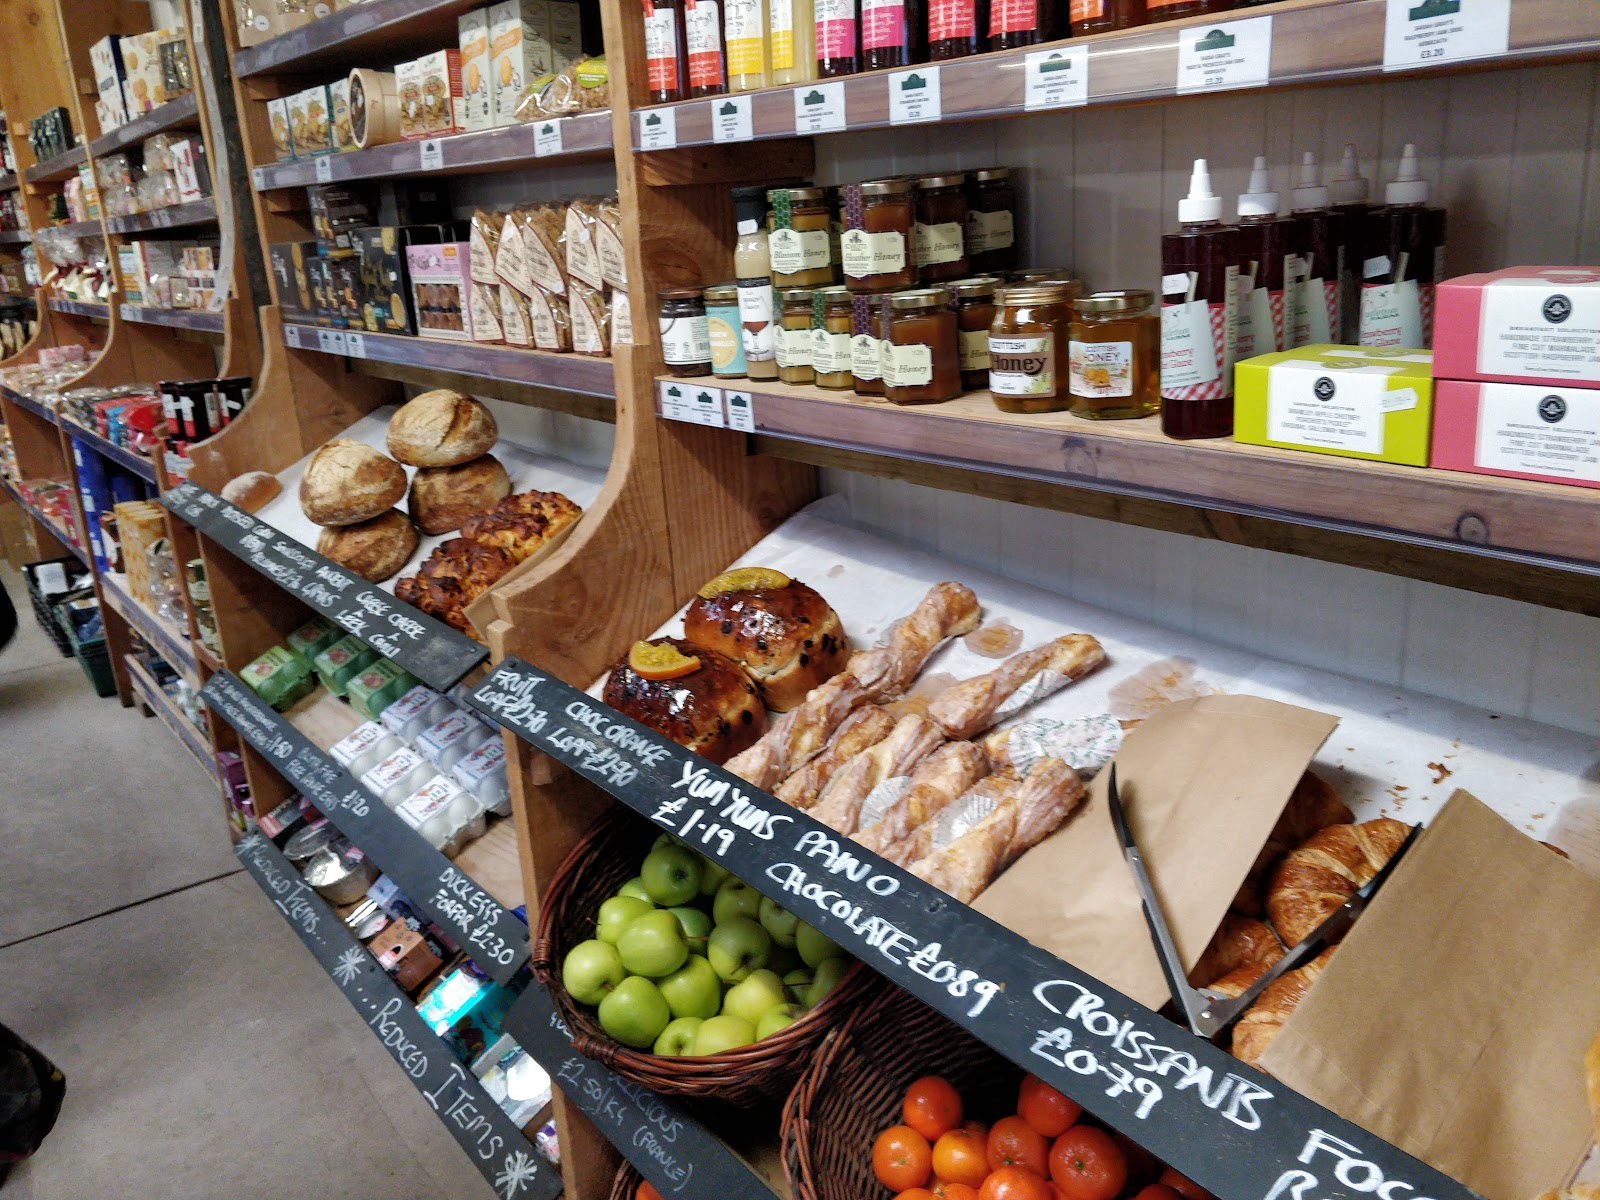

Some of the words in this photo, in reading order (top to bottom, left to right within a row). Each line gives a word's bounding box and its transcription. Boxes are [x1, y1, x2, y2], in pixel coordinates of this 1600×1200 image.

[803, 248, 826, 259] Honey
[873, 252, 901, 262] Honey
[991, 341, 1026, 350] SCOTTISH
[1499, 333, 1540, 341] HANDMADE
[1542, 335, 1593, 344] STRAWBERRY
[1512, 342, 1529, 350] FINE
[1547, 344, 1597, 354] MARMALADE
[898, 364, 928, 375] Honey
[993, 355, 1048, 376] Honey
[491, 669, 546, 697] FRUIT
[473, 684, 519, 713] LOAF
[546, 727, 597, 757] LOAF
[565, 701, 610, 736] CHOC
[604, 725, 672, 767] ORANGE
[670, 760, 731, 806] YUM
[719, 788, 794, 840] YUMS
[439, 867, 474, 901] DUCK
[468, 891, 503, 926] EGGS
[765, 862, 918, 965] CHOCOLATE
[1032, 979, 1276, 1131] CROISSANTS
[423, 1062, 504, 1160] ITEMS
